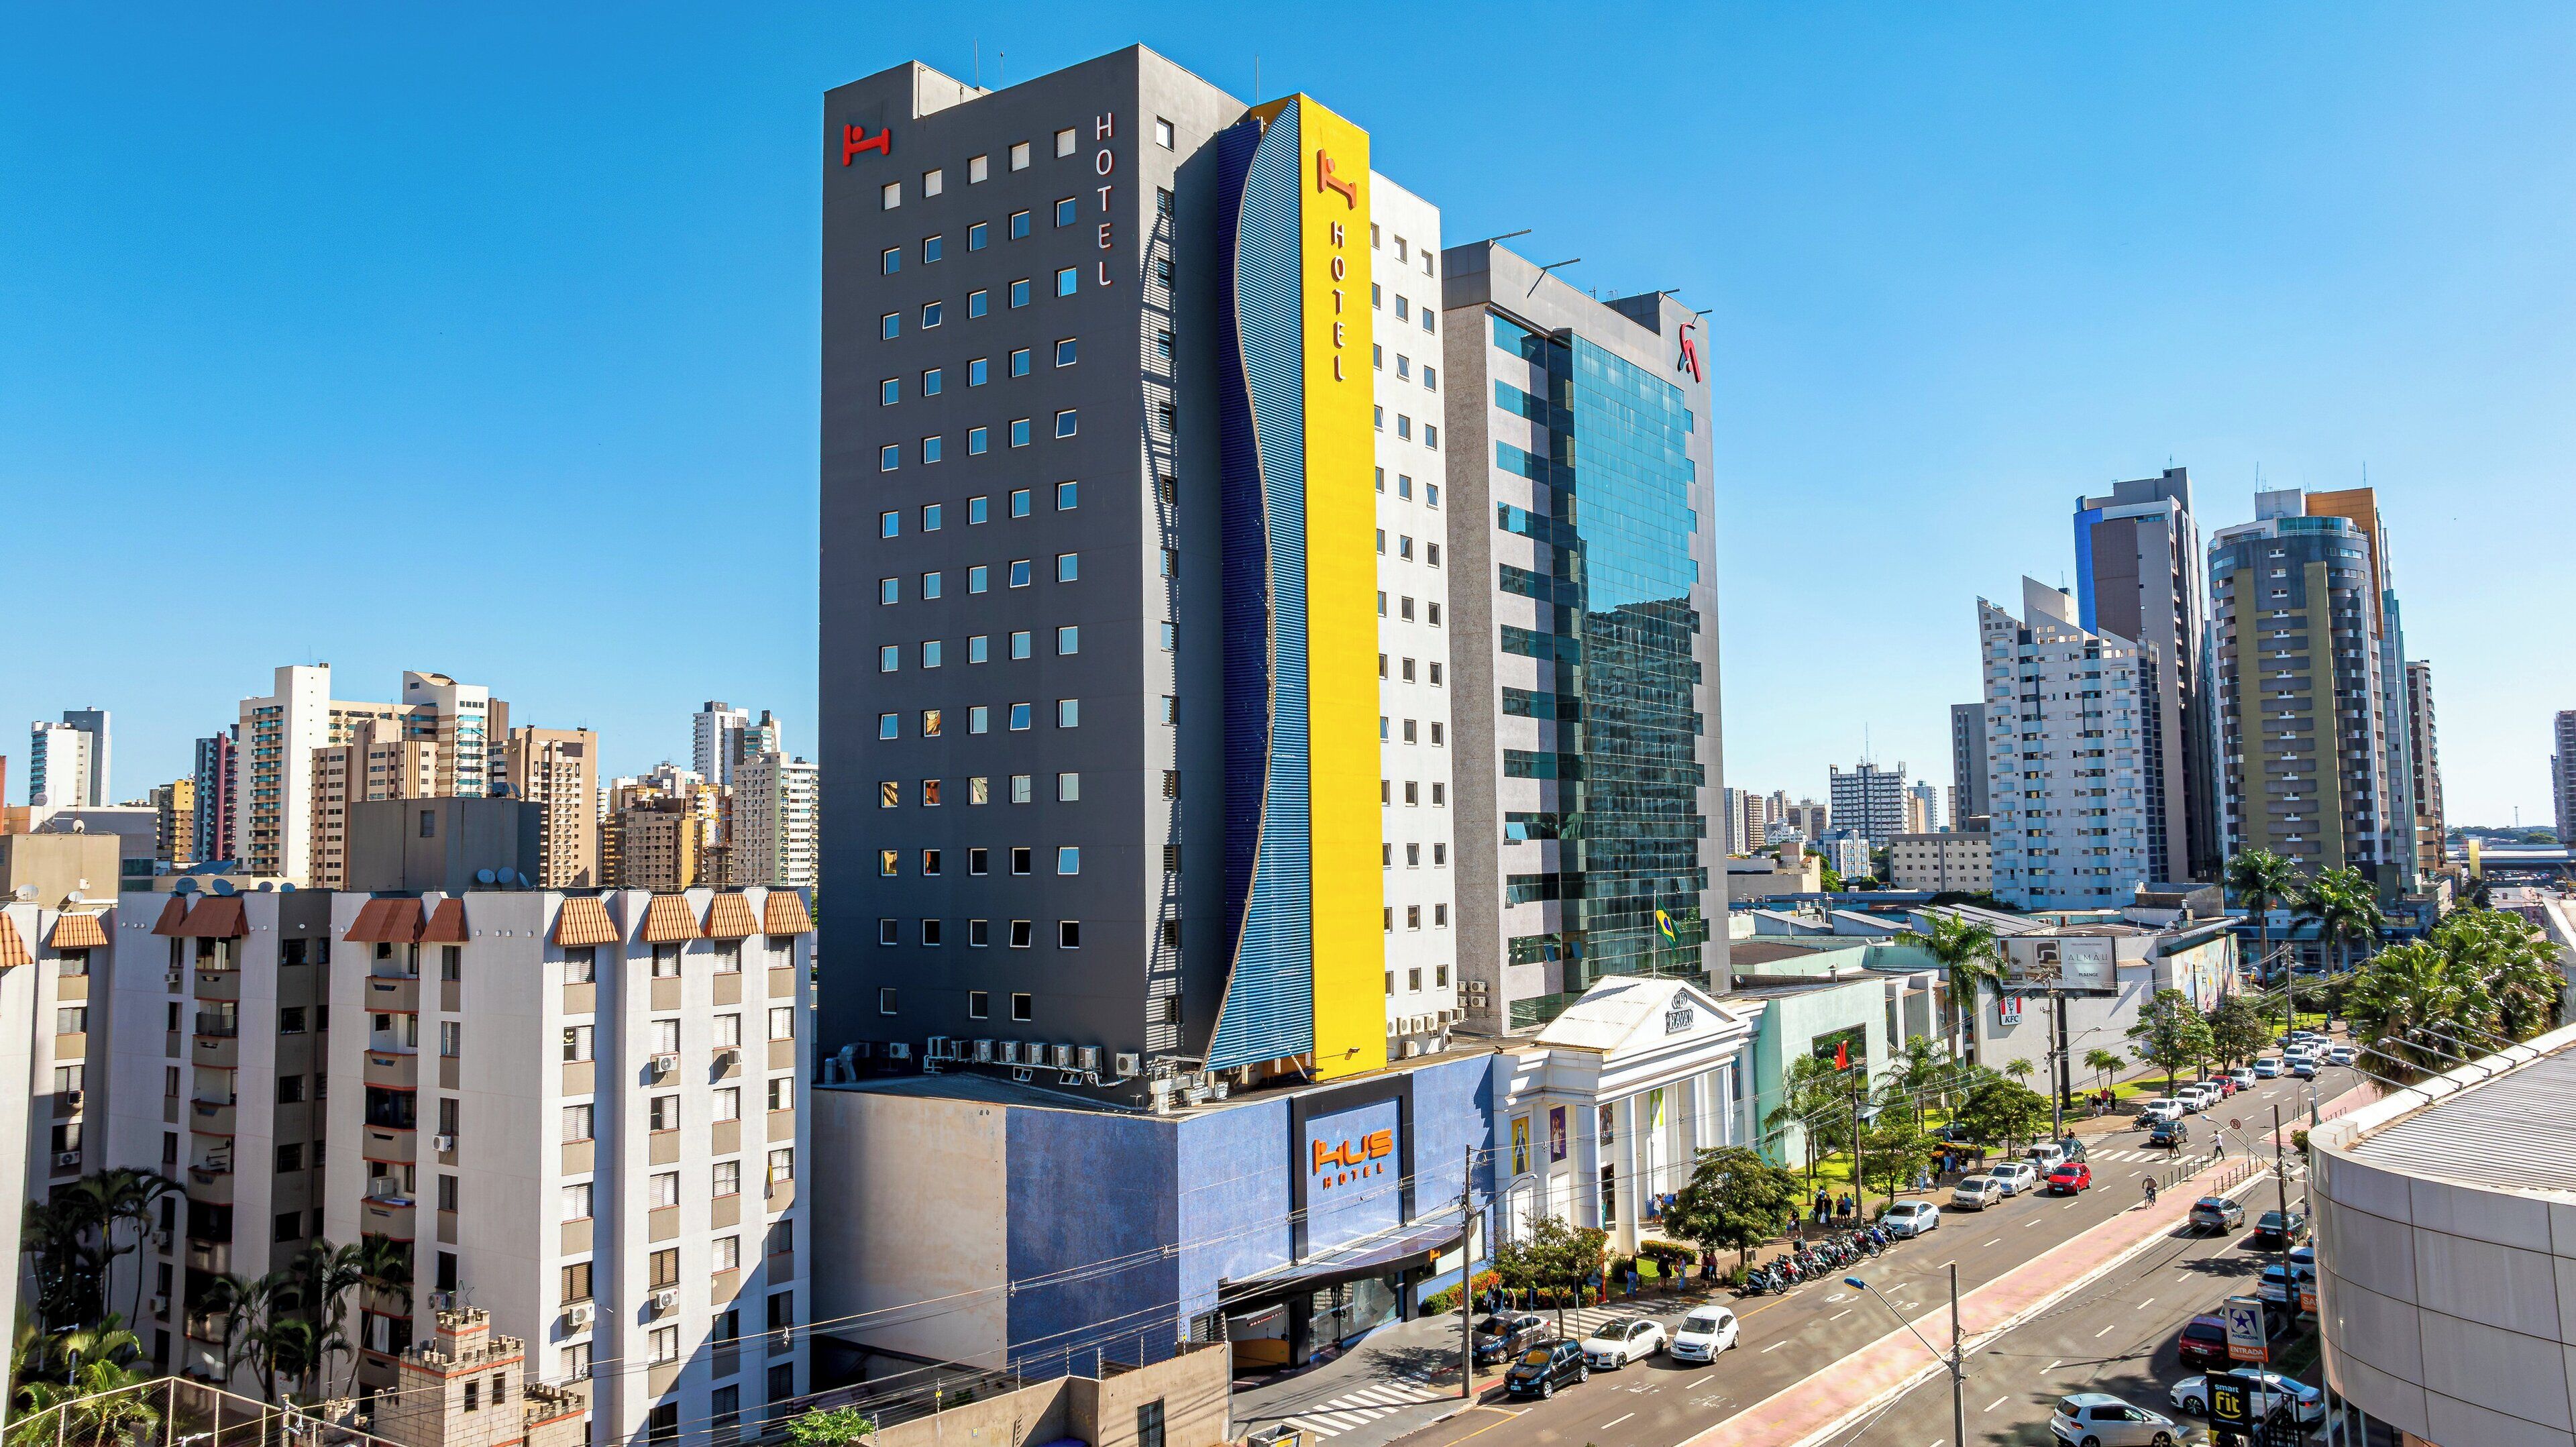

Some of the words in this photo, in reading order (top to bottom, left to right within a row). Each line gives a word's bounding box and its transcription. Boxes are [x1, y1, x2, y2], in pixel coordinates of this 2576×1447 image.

[1096, 112, 1113, 286] HOTEL
[1331, 220, 1346, 382] HOTEL
[1667, 1009, 1693, 1030] HAVAN
[2005, 1015, 2019, 1023] KFC
[1324, 1163, 1384, 1189] HOTEL
[2231, 1346, 2264, 1355] ENTRADA
[2214, 1384, 2239, 1393] smart
[2215, 1391, 2241, 1413] fit
